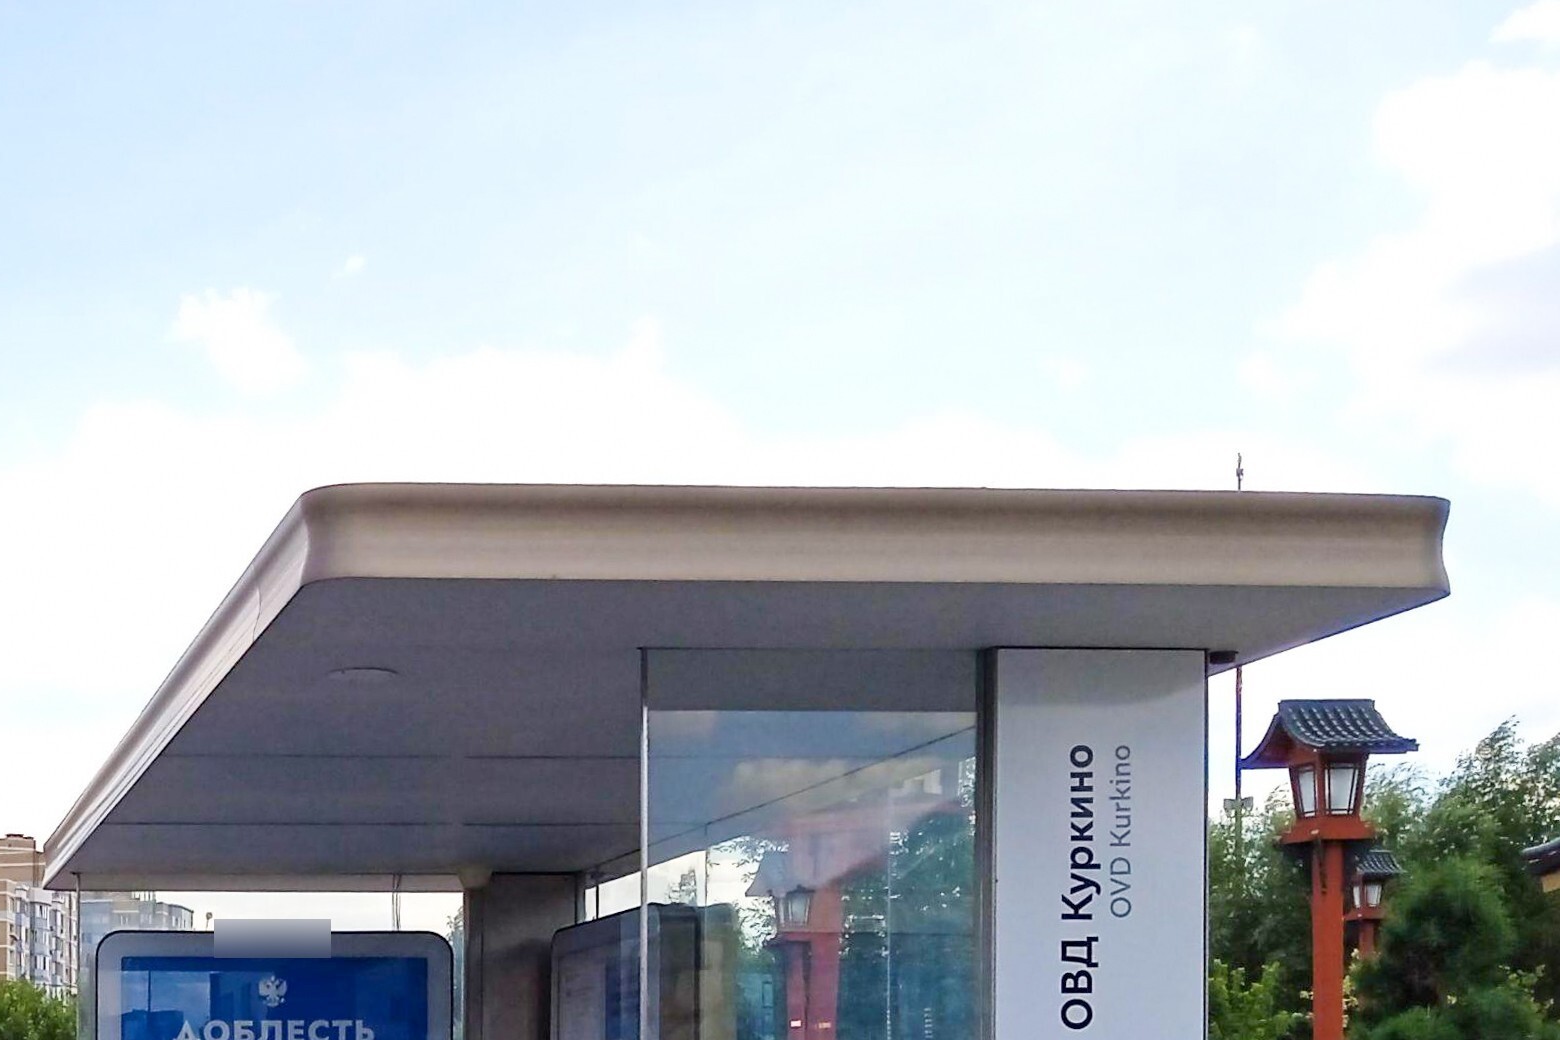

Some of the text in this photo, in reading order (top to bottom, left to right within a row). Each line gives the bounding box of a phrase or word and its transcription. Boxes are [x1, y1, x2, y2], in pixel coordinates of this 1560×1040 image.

[1060, 744, 1101, 1030] ОВД Куркино
[1109, 745, 1132, 918] OVD Kurkino
